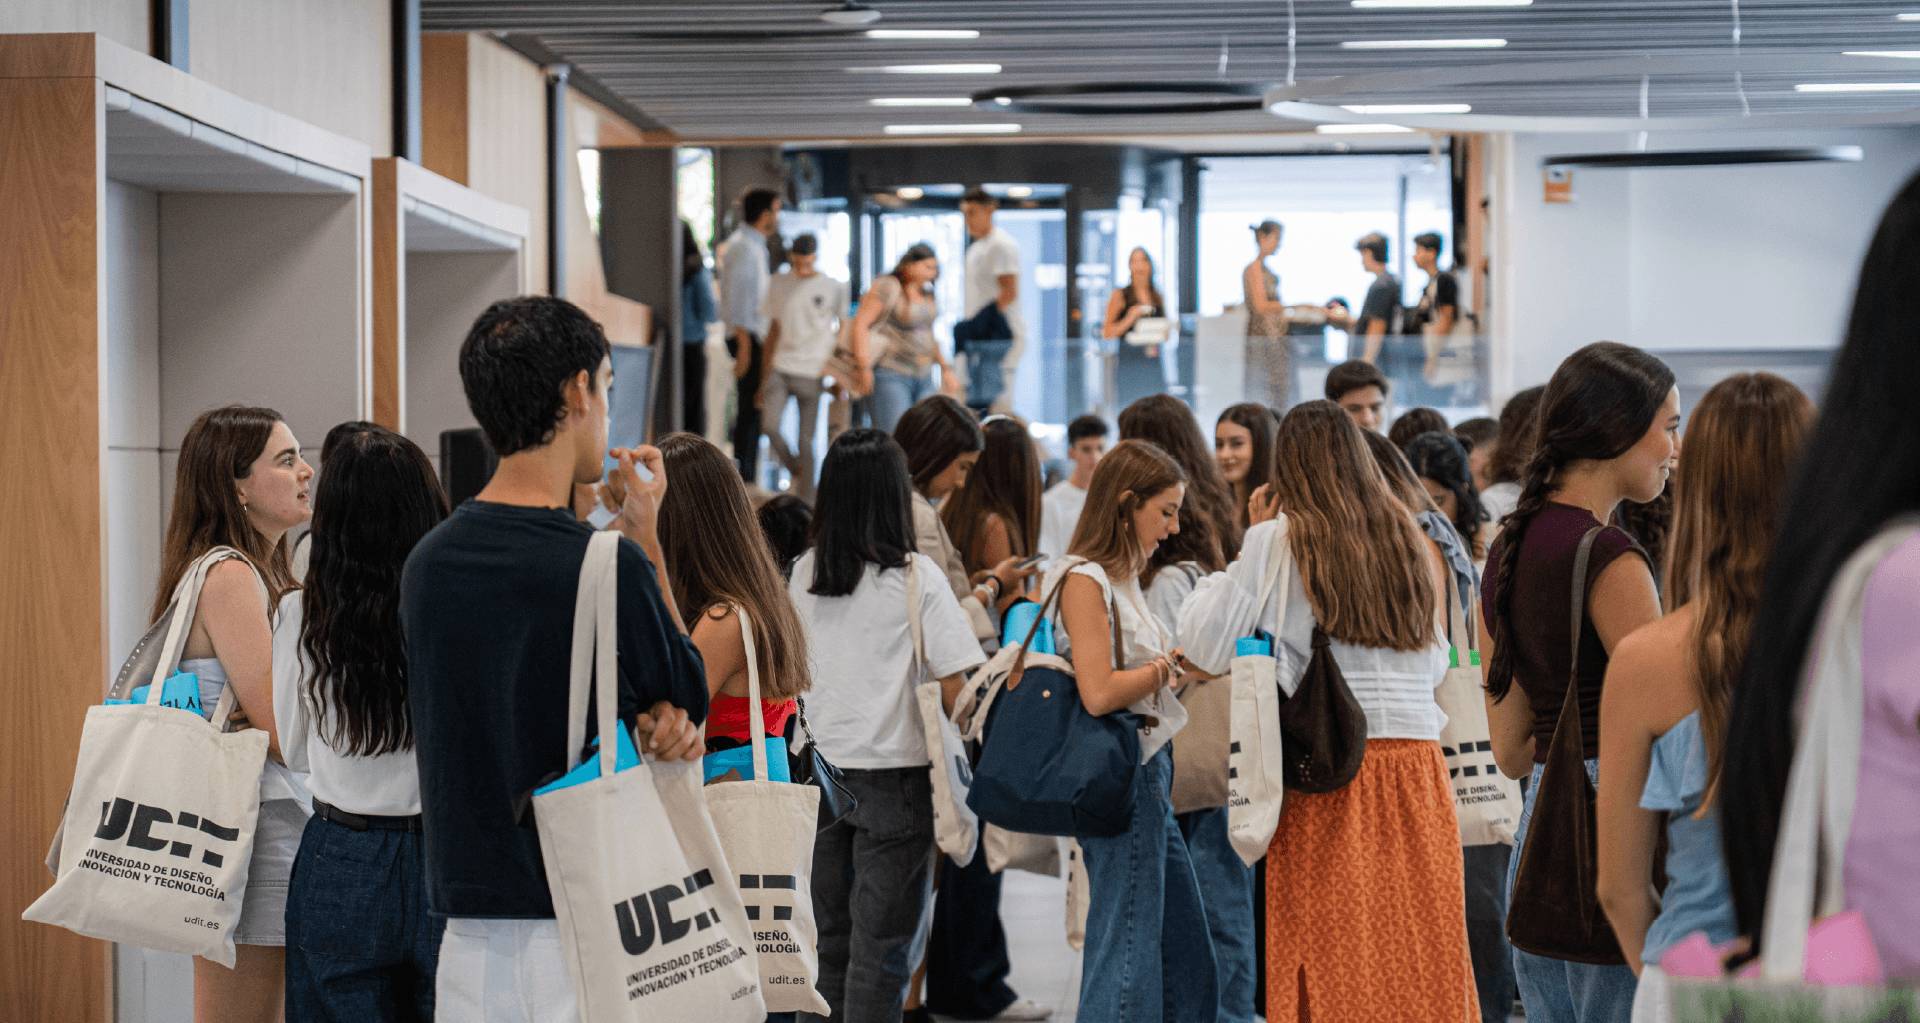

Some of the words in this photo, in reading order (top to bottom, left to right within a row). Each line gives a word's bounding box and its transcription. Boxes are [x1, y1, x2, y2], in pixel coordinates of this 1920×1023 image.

[1456, 787, 1468, 796] DE
[94, 797, 240, 868] UDIT
[86, 849, 150, 871] IVERSIDAD
[153, 865, 167, 875] DE
[170, 867, 215, 887] DISEÑO,
[144, 874, 152, 884] Y
[154, 876, 225, 901] TECNOLOGÍA
[184, 916, 220, 930] udit.es
[753, 930, 791, 942] ISEÑO,
[756, 942, 802, 953] NOLOGÍA
[626, 954, 690, 986] UNIVERSIDAD
[692, 948, 705, 962] DE
[628, 971, 687, 1001] INNOVACIÓN
[690, 967, 697, 979] Y
[769, 974, 805, 985] udit.es
